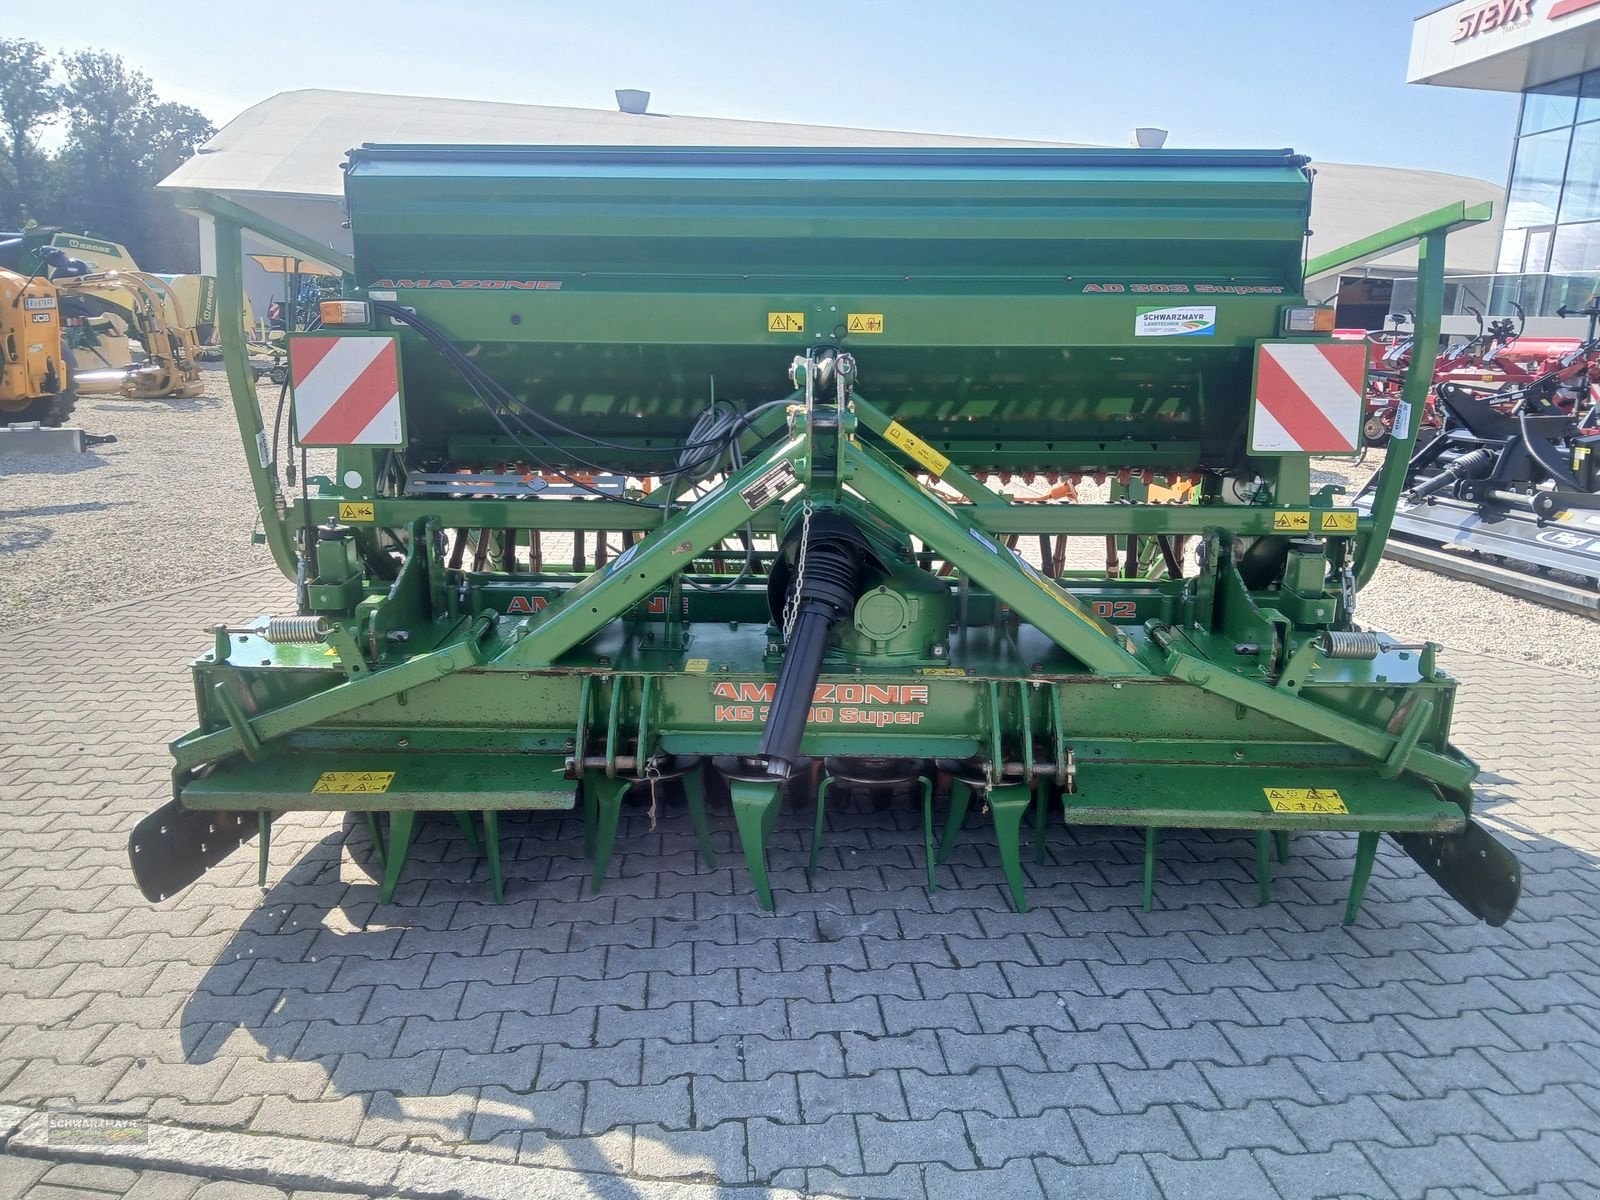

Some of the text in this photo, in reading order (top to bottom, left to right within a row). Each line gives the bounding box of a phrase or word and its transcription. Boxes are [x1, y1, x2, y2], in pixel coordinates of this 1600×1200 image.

[1450, 0, 1533, 43] STEYR
[368, 279, 563, 290] AMAZONE
[1082, 283, 1125, 293] AD
[1195, 284, 1284, 295] Super
[33, 314, 50, 322] JCB
[1143, 313, 1204, 321] SCHWARZMAYR
[713, 682, 928, 704] AMZONE
[714, 705, 755, 722] KG
[839, 707, 925, 728] Super
